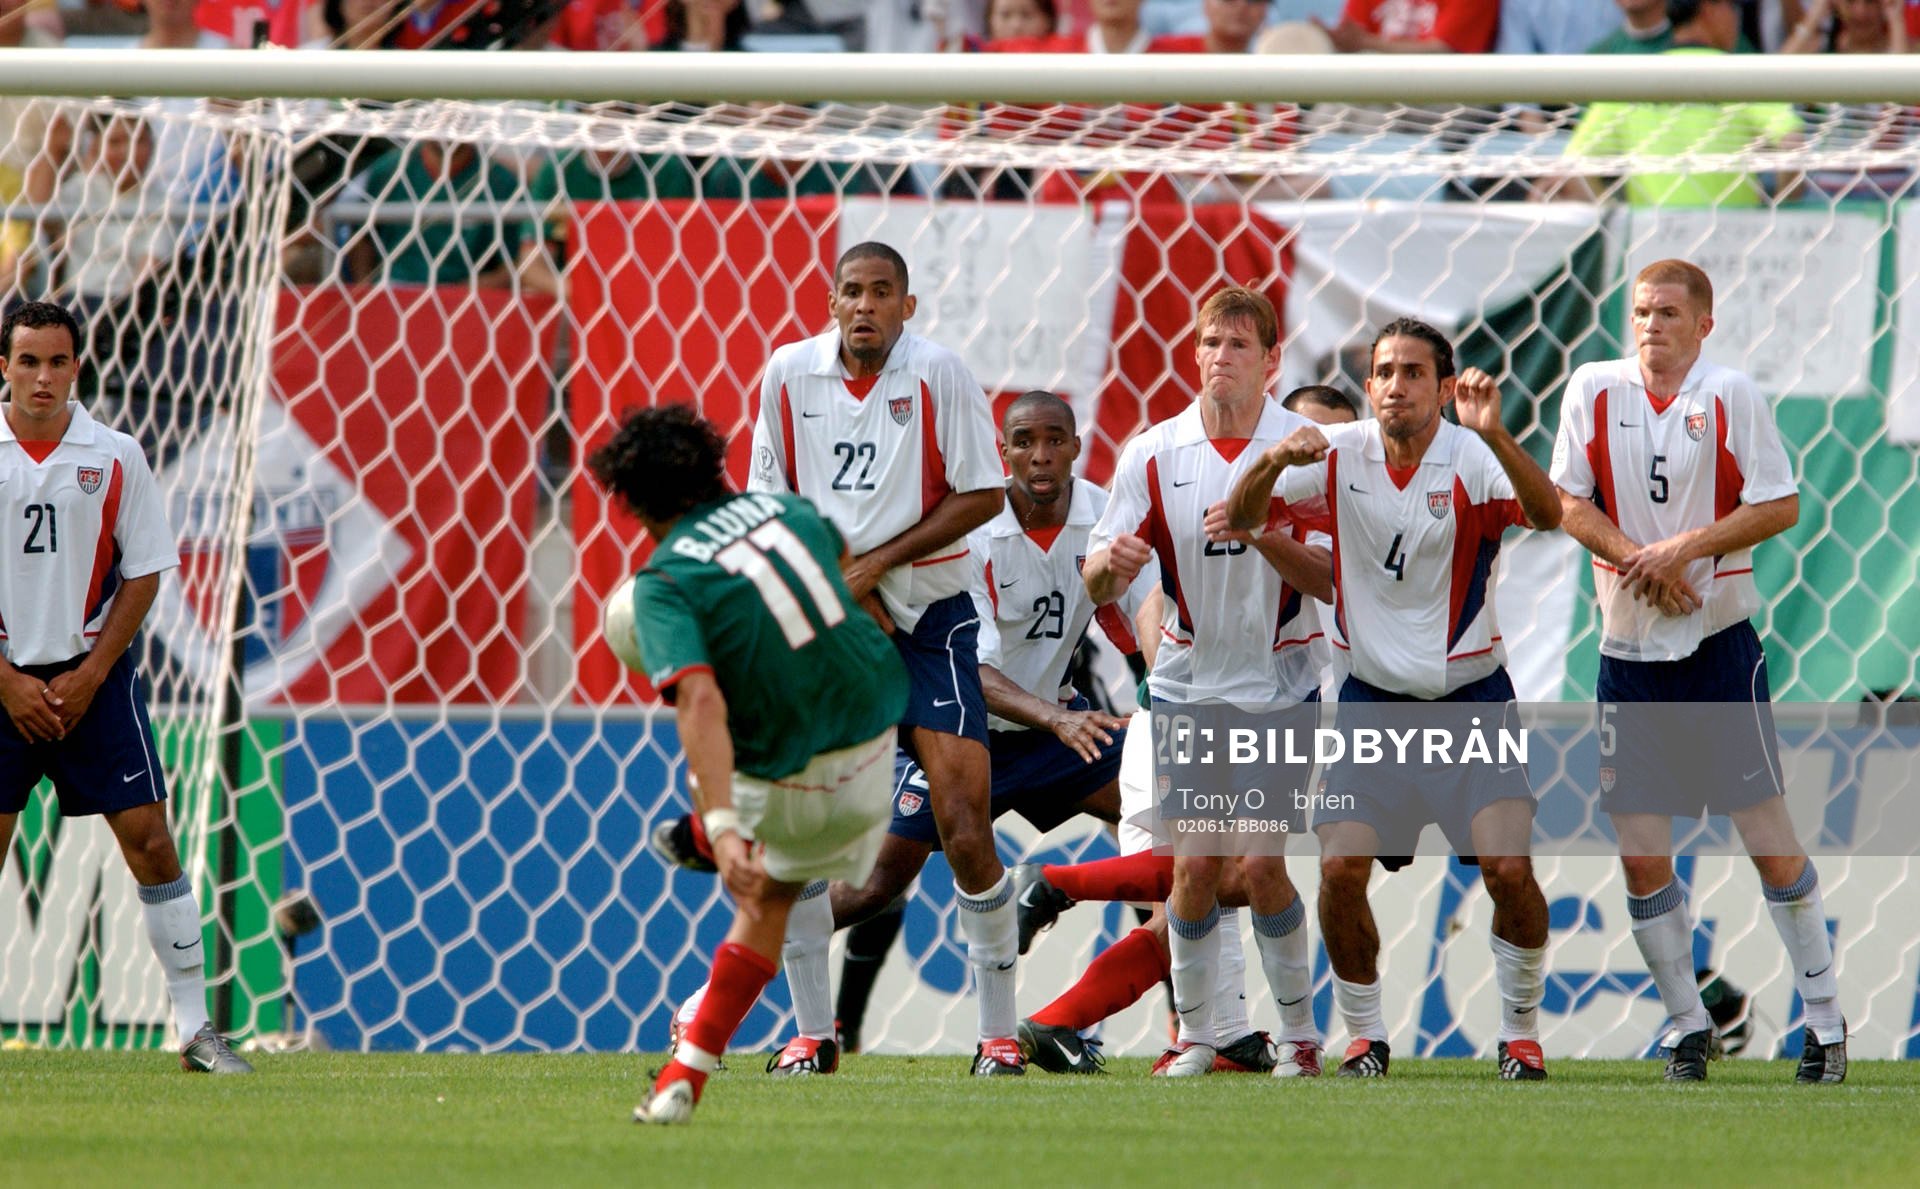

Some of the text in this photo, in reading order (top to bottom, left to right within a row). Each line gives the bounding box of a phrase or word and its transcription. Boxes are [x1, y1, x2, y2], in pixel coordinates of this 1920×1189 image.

[831, 441, 877, 491] 22
[1650, 454, 1669, 504] 5
[23, 503, 57, 554] 21
[672, 494, 787, 564] B.LUNA
[1384, 533, 1406, 581] 4
[714, 518, 846, 650] 11
[1025, 590, 1065, 640] 23
[1155, 713, 1195, 765] 20
[1600, 703, 1618, 756] 5
